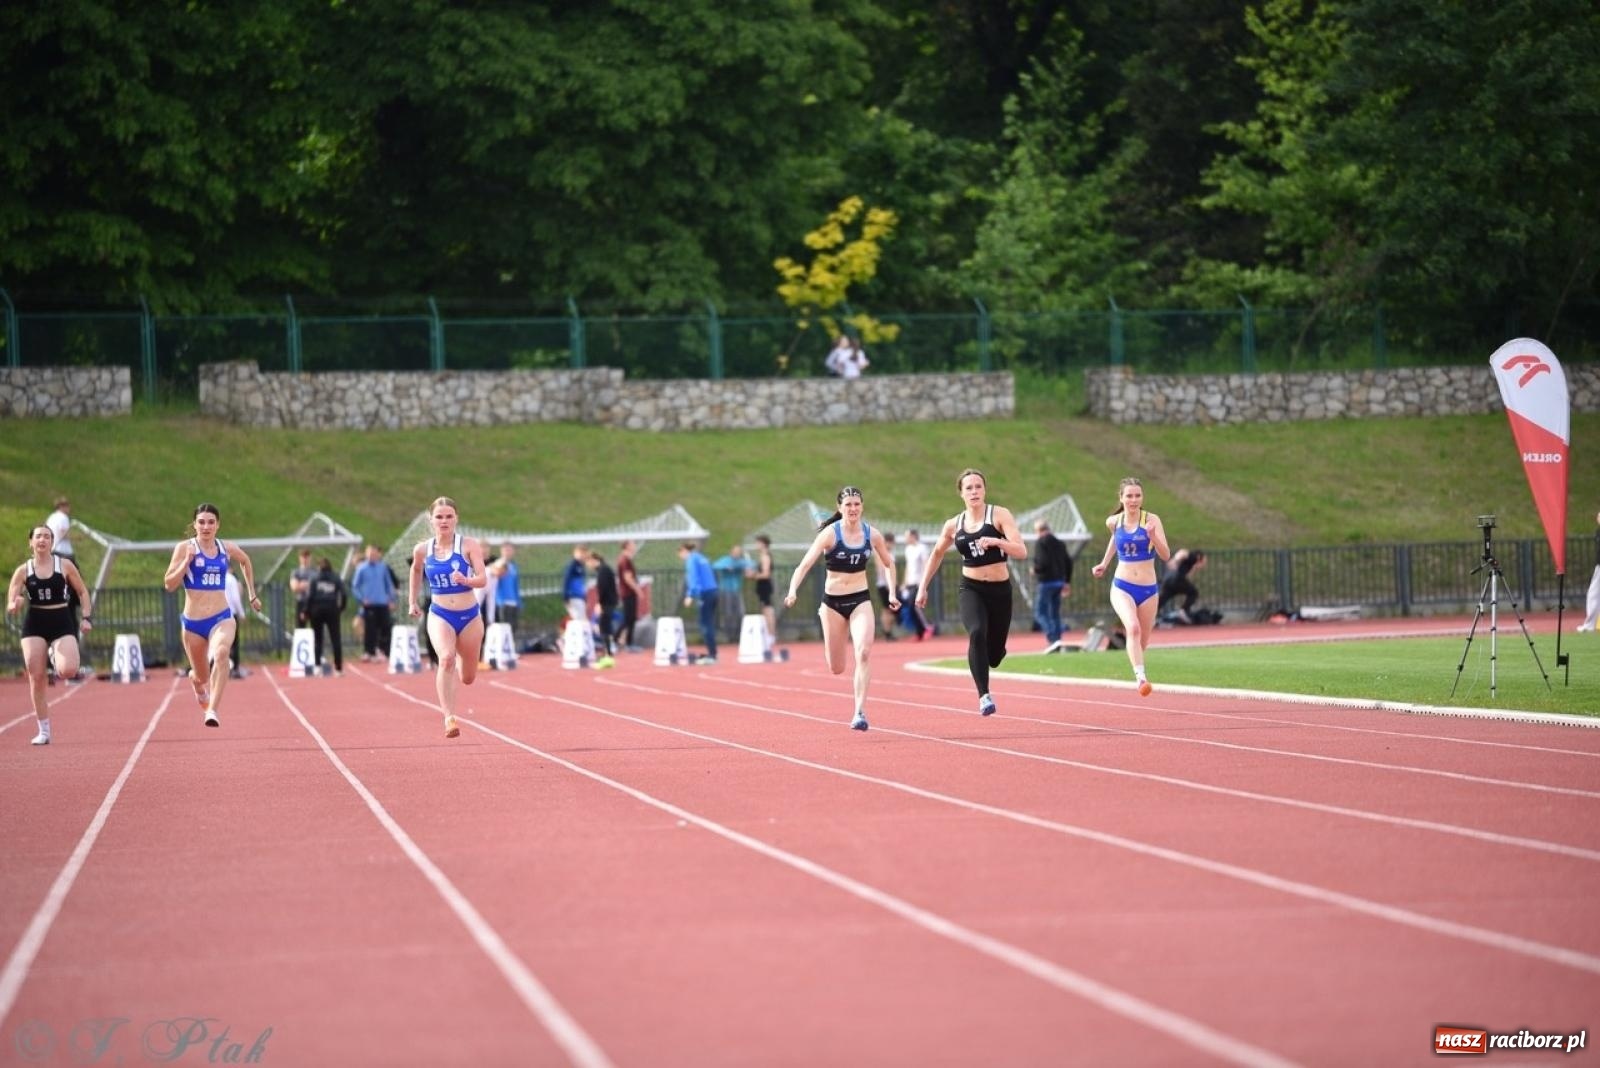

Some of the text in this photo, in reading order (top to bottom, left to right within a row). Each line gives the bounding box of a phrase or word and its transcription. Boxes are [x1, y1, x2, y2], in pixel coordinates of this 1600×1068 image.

[1123, 543, 1138, 557] 22
[850, 553, 861, 565] 17
[296, 639, 310, 664] 6
